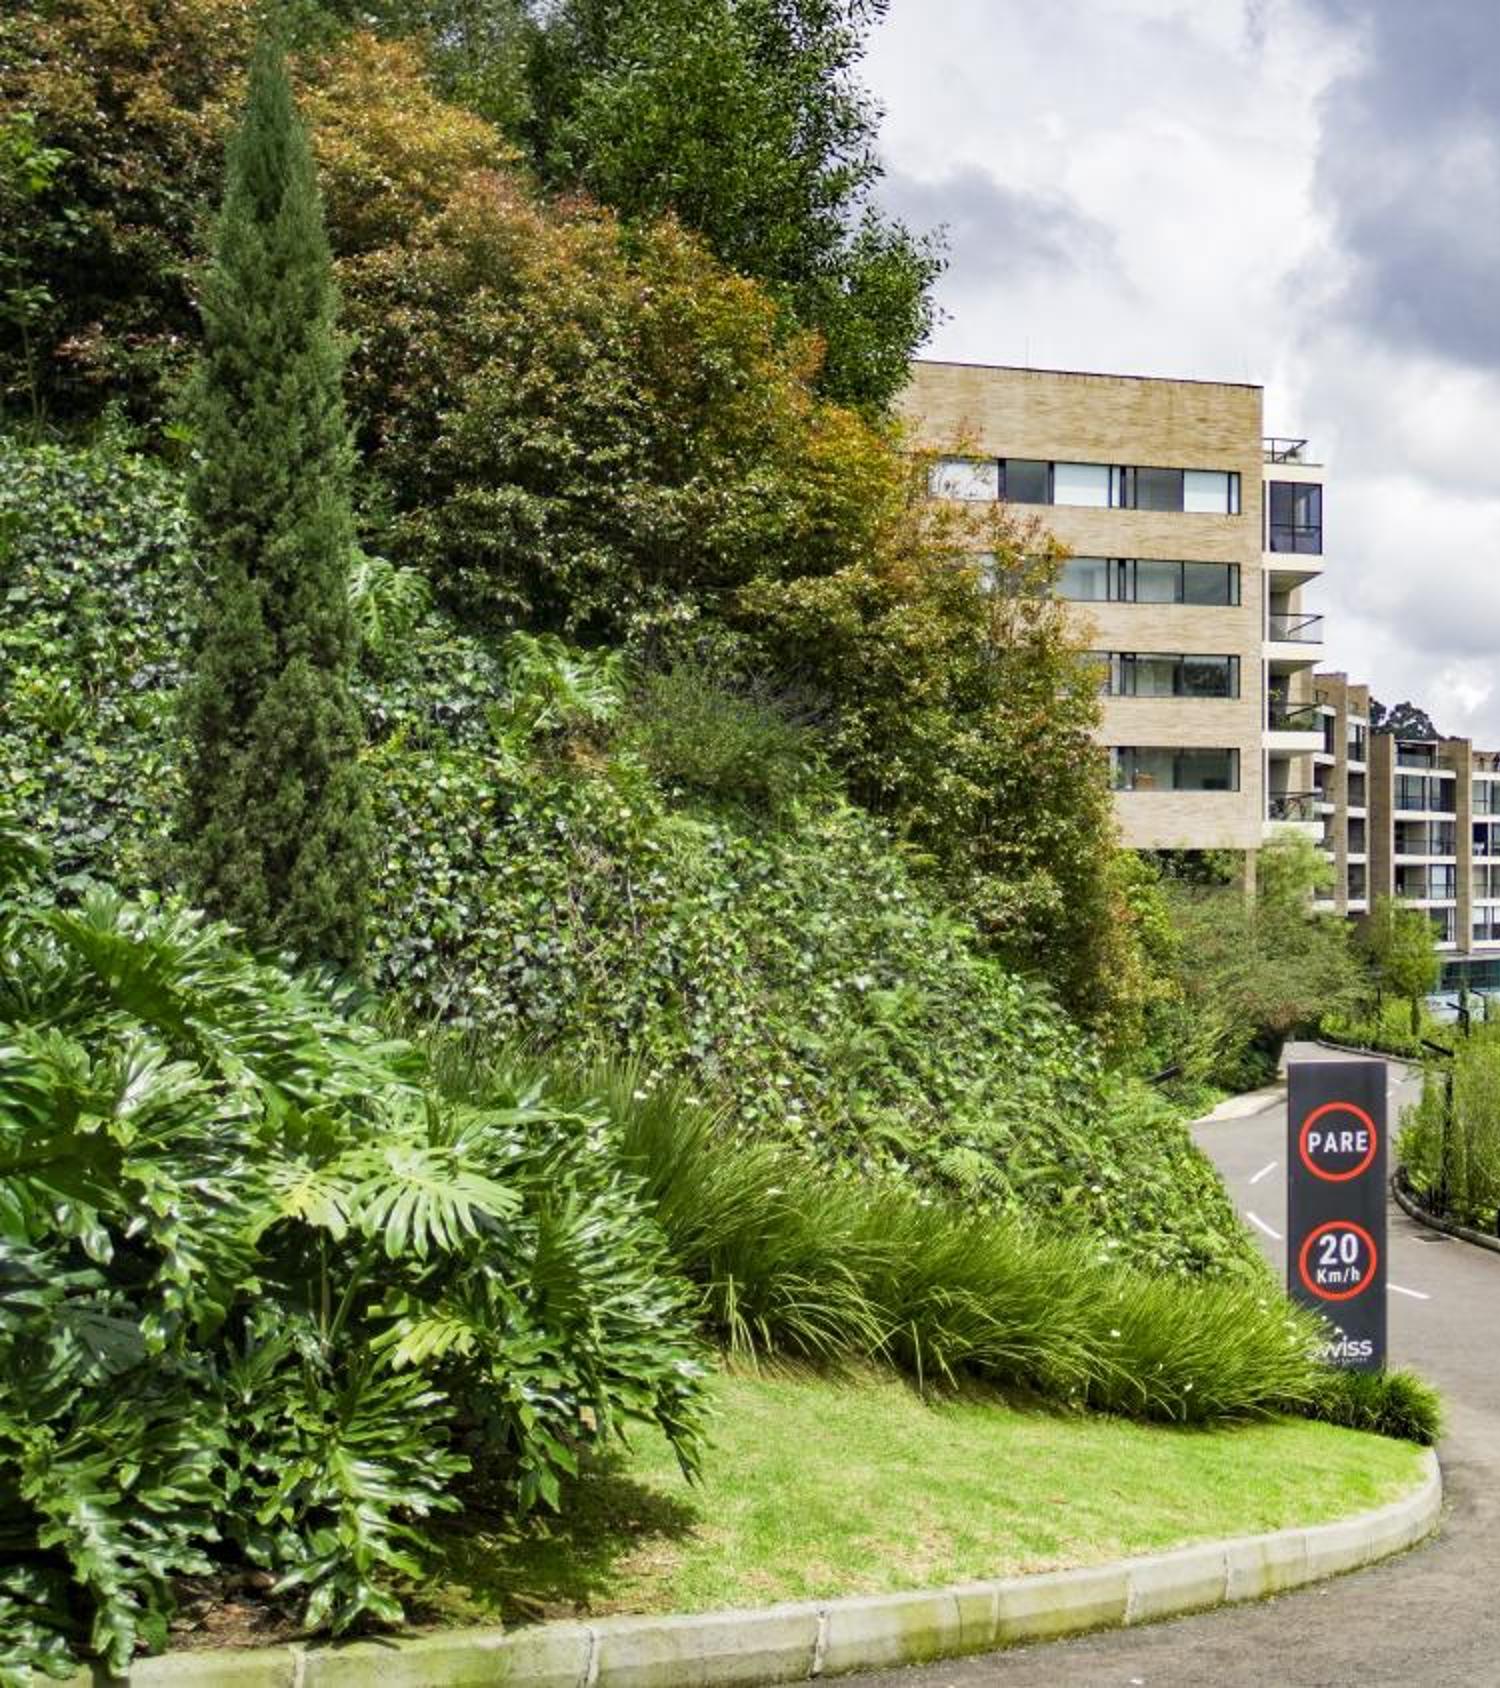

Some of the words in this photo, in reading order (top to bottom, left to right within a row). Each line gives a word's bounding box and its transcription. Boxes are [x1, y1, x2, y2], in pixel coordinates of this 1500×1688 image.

[1308, 1130, 1369, 1153] PARE
[1319, 1232, 1359, 1265] 20
[1316, 1266, 1361, 1284] Km/h
